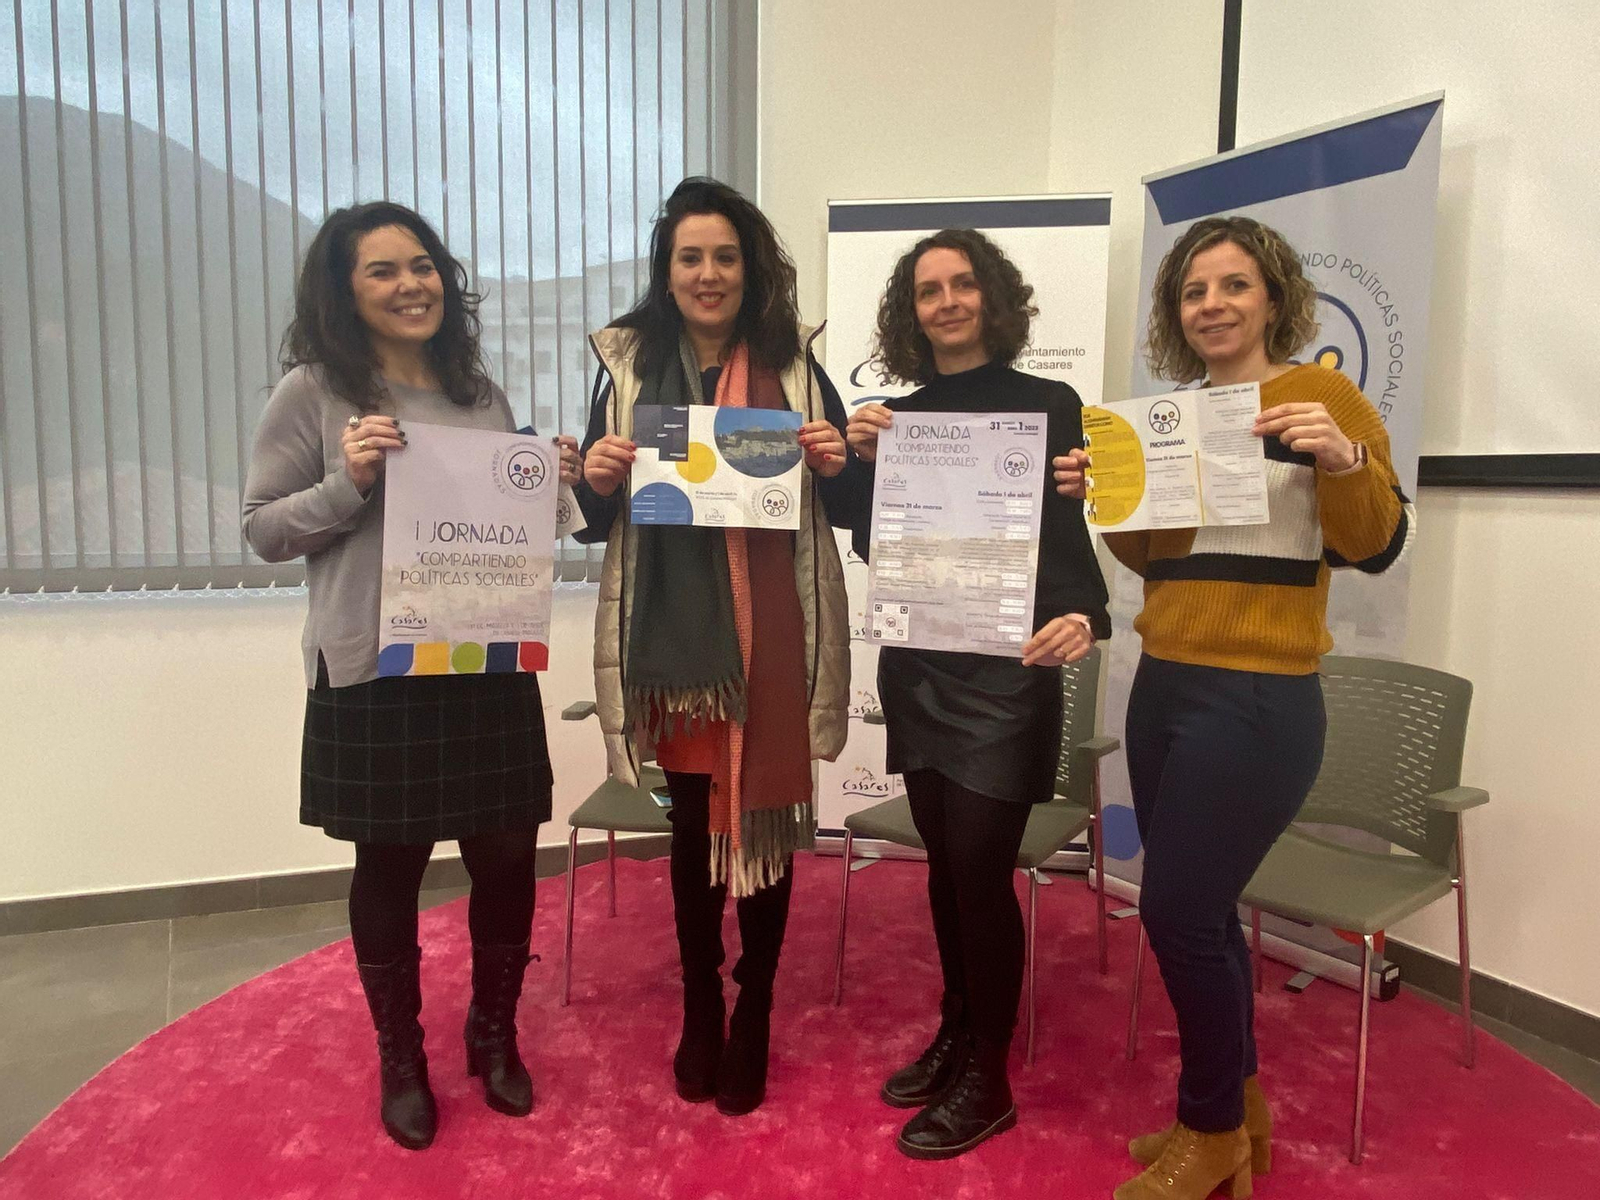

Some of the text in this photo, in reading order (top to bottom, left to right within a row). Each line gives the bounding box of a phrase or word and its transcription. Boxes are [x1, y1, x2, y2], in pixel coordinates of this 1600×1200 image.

[1340, 258, 1399, 327] POLÍTICAS
[1018, 347, 1086, 360] yuntamiento
[1027, 360, 1073, 370] Casares
[894, 424, 972, 440] I JORNADA
[989, 421, 1000, 431] 31
[1018, 421, 1023, 431] 1
[1150, 439, 1186, 448] PROGRAMA
[884, 453, 931, 466] POLÍTICAS
[415, 520, 529, 546] I JORNADA
[400, 568, 470, 586] POLÍTICAS
[842, 779, 889, 791] Casares
